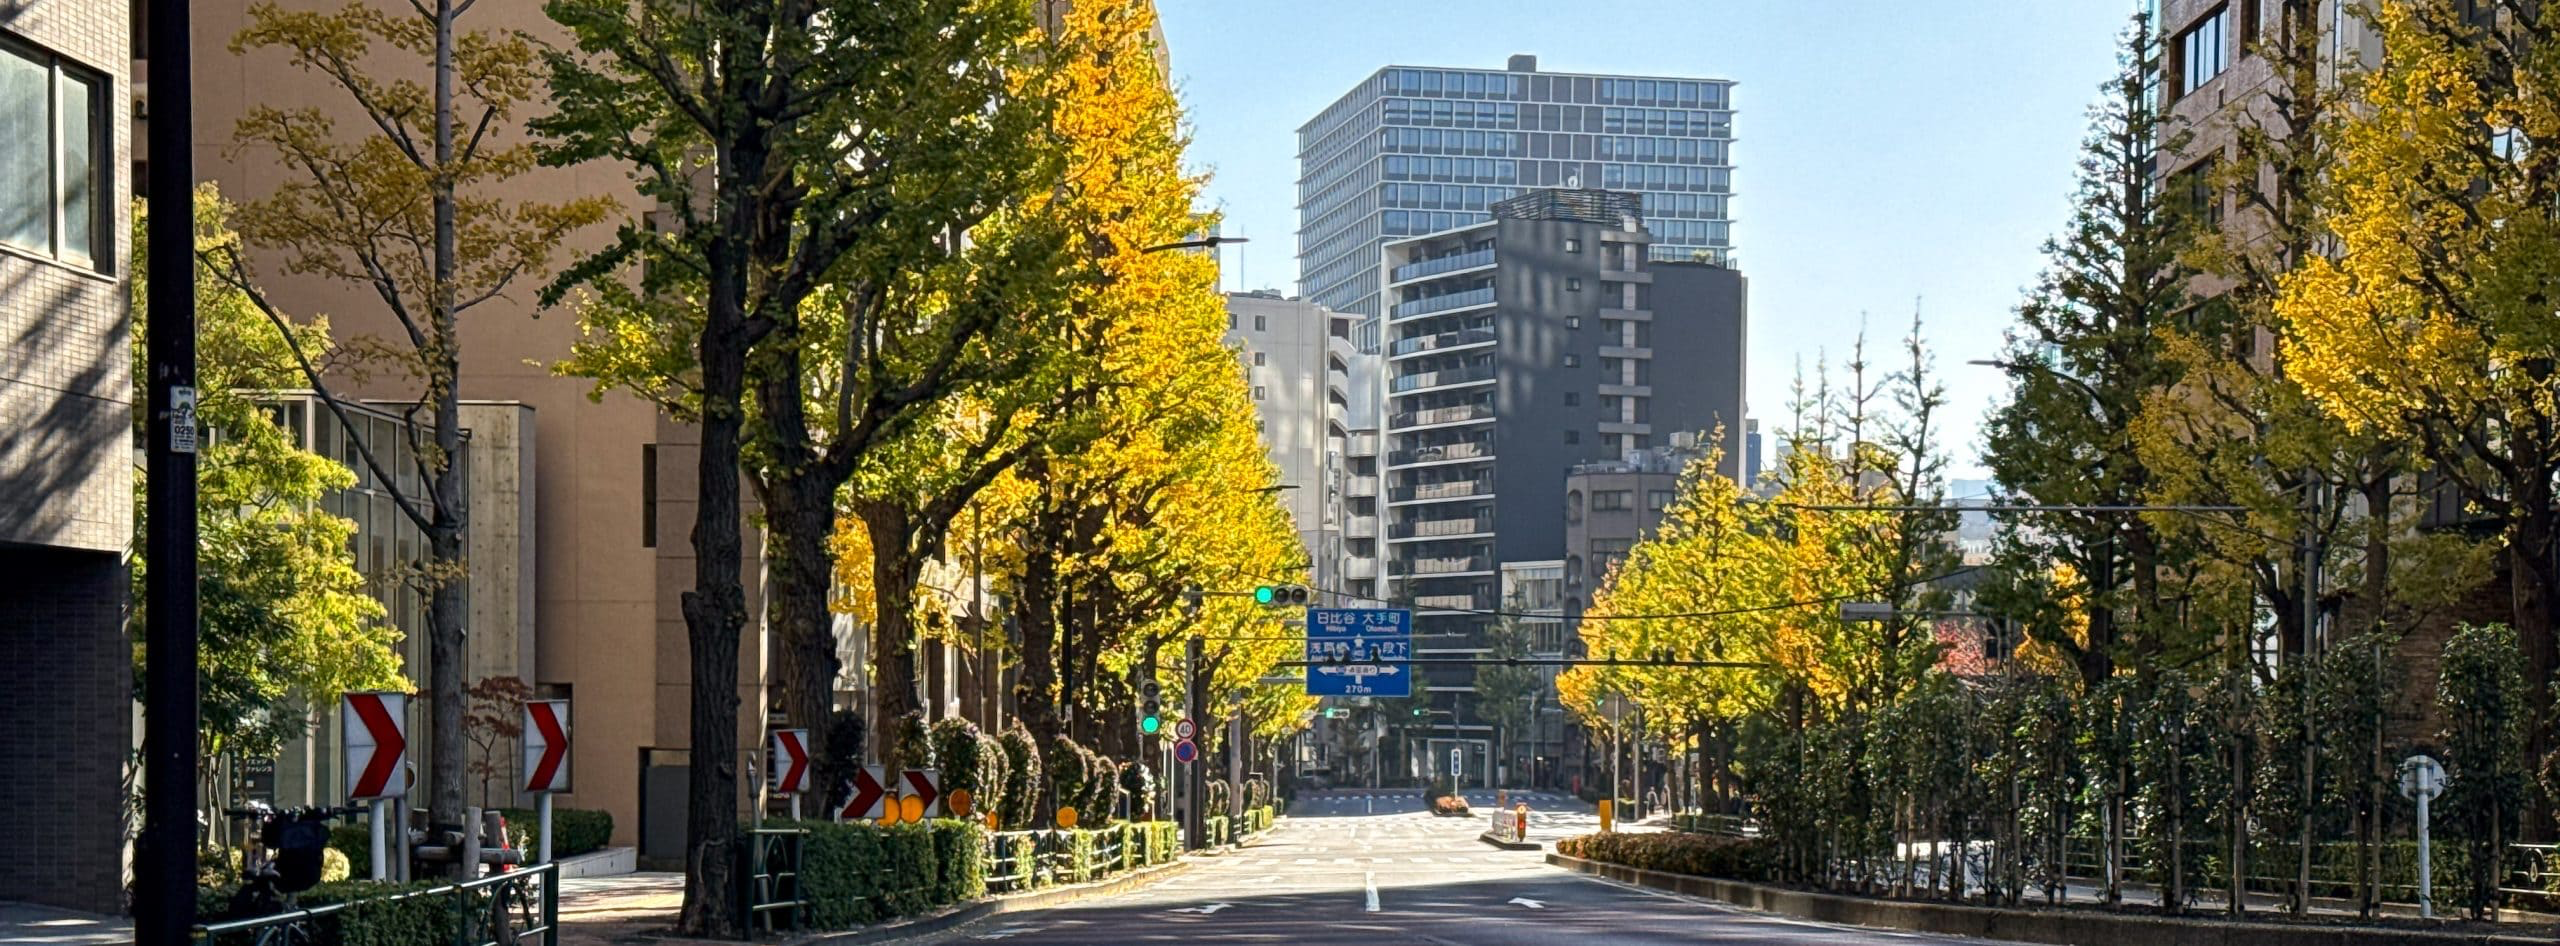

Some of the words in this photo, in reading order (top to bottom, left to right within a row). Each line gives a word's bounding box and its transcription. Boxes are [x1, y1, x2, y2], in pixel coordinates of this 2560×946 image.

[1317, 612, 1355, 624] 日比谷
[1362, 612, 1400, 624] 大手町
[1345, 685, 1371, 693] 270m
[1180, 724, 1191, 734] 40
